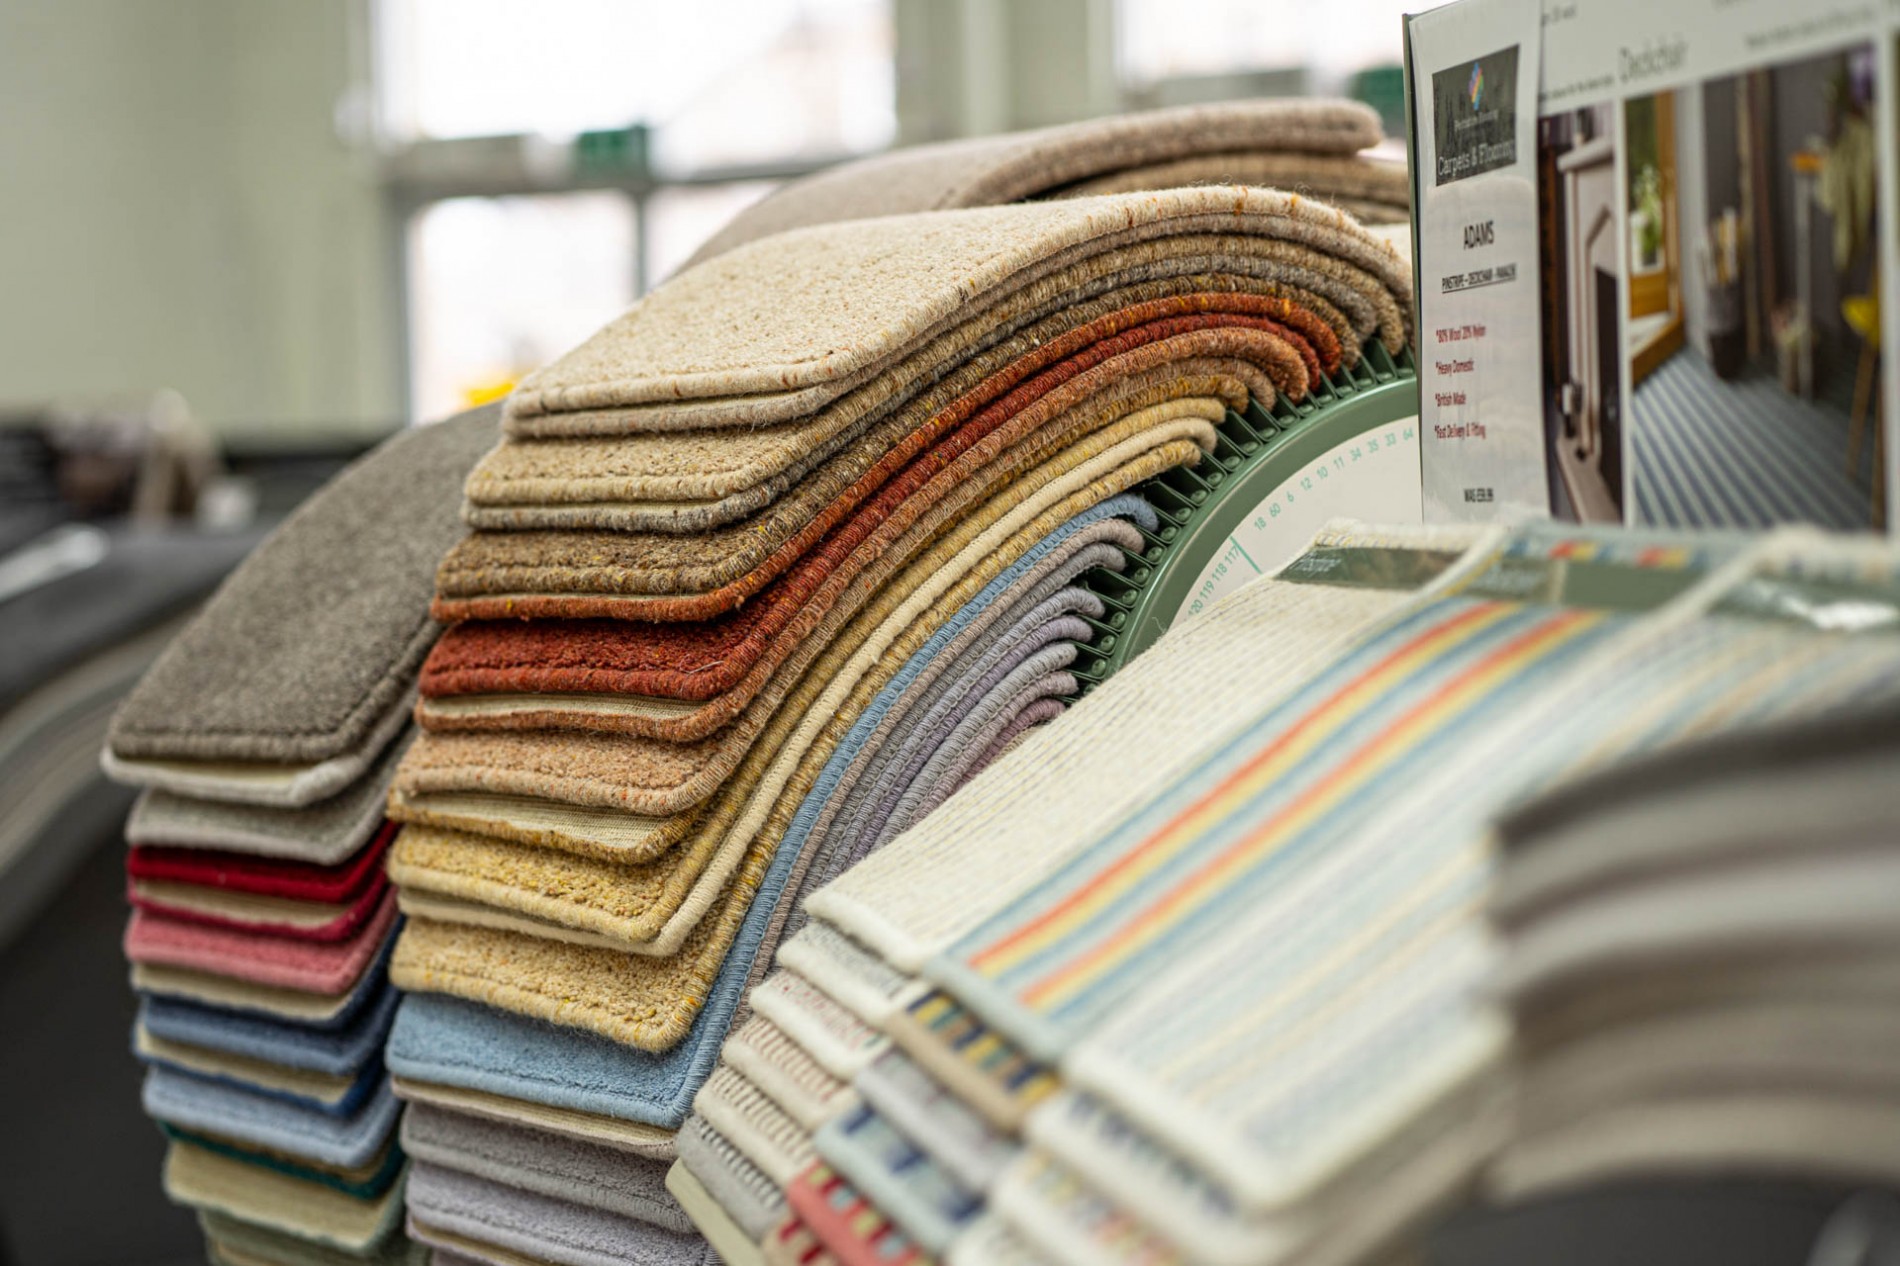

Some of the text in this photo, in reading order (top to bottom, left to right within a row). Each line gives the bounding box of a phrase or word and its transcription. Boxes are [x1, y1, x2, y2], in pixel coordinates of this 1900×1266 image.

[1438, 153, 1470, 177] Carpets
[1463, 220, 1494, 251] ADAMS
[1254, 516, 1266, 531] 18
[1286, 490, 1295, 502] 6
[1300, 477, 1312, 491] 12
[1317, 466, 1328, 479] 10
[1333, 455, 1345, 470] 11
[1350, 447, 1362, 461] 34
[1367, 438, 1379, 453] 35
[1385, 432, 1396, 447] 33
[1402, 427, 1414, 441] 64
[1188, 545, 1240, 615] 120 119 118 117
